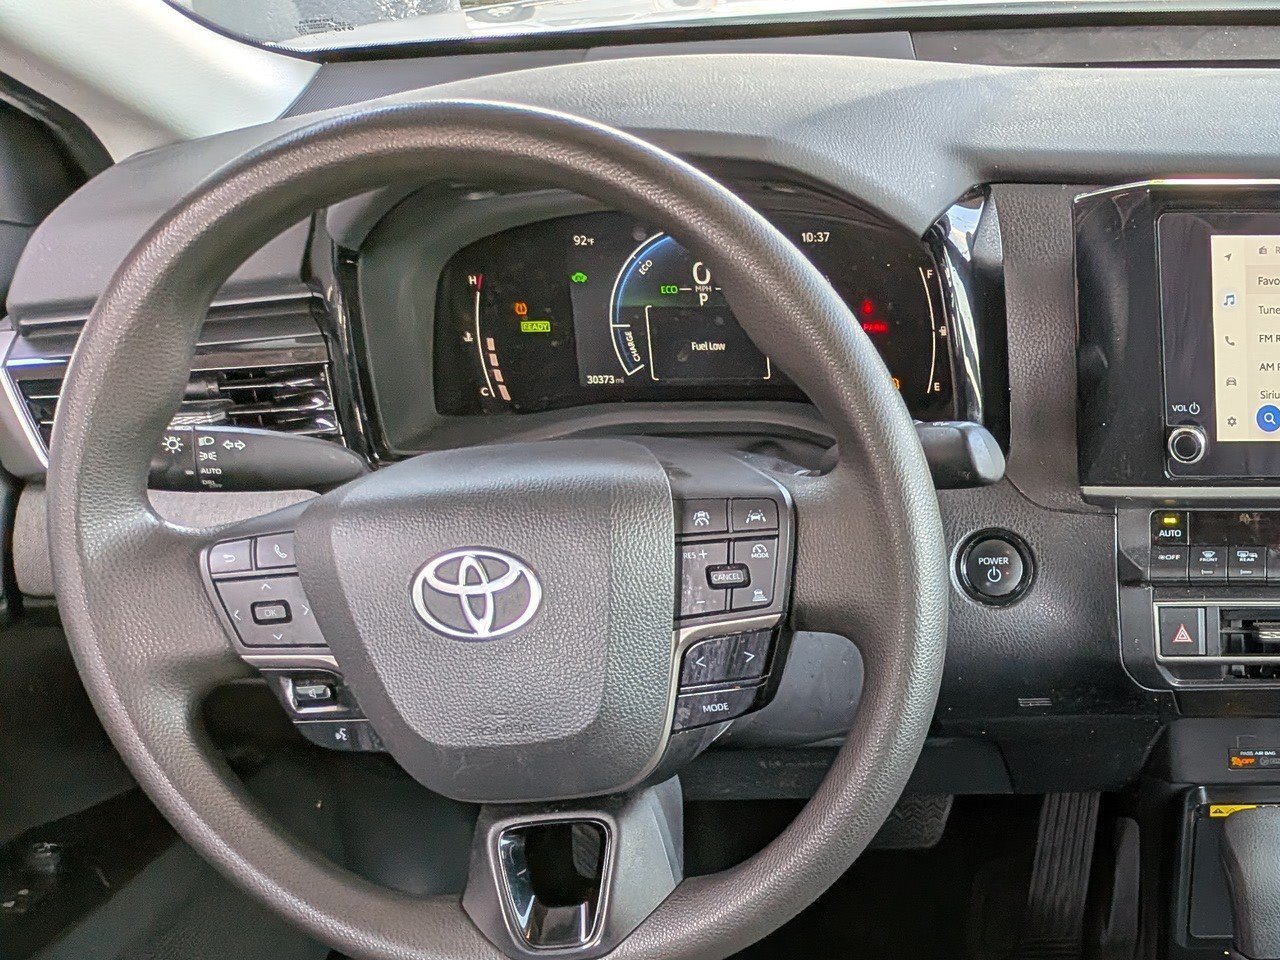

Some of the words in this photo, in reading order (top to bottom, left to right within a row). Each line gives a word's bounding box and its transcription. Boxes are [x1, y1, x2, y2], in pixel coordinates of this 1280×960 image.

[802, 232, 830, 243] 10:37
[638, 259, 653, 275] ECO
[926, 269, 933, 279] F
[468, 275, 477, 285] H
[661, 285, 678, 294] ECO
[699, 293, 709, 306] P
[1258, 334, 1273, 343] FM
[624, 331, 641, 362] CHARGE
[691, 342, 708, 351] Fuel
[709, 342, 726, 351] Low
[1259, 363, 1275, 371] AM
[587, 375, 615, 384] 30373
[934, 382, 940, 392] E
[481, 387, 489, 397] C
[201, 467, 222, 475] AUTO
[978, 557, 1009, 565] POWER
[713, 573, 741, 581] CANCEL
[264, 609, 277, 617] OK
[702, 702, 730, 713] MODE
